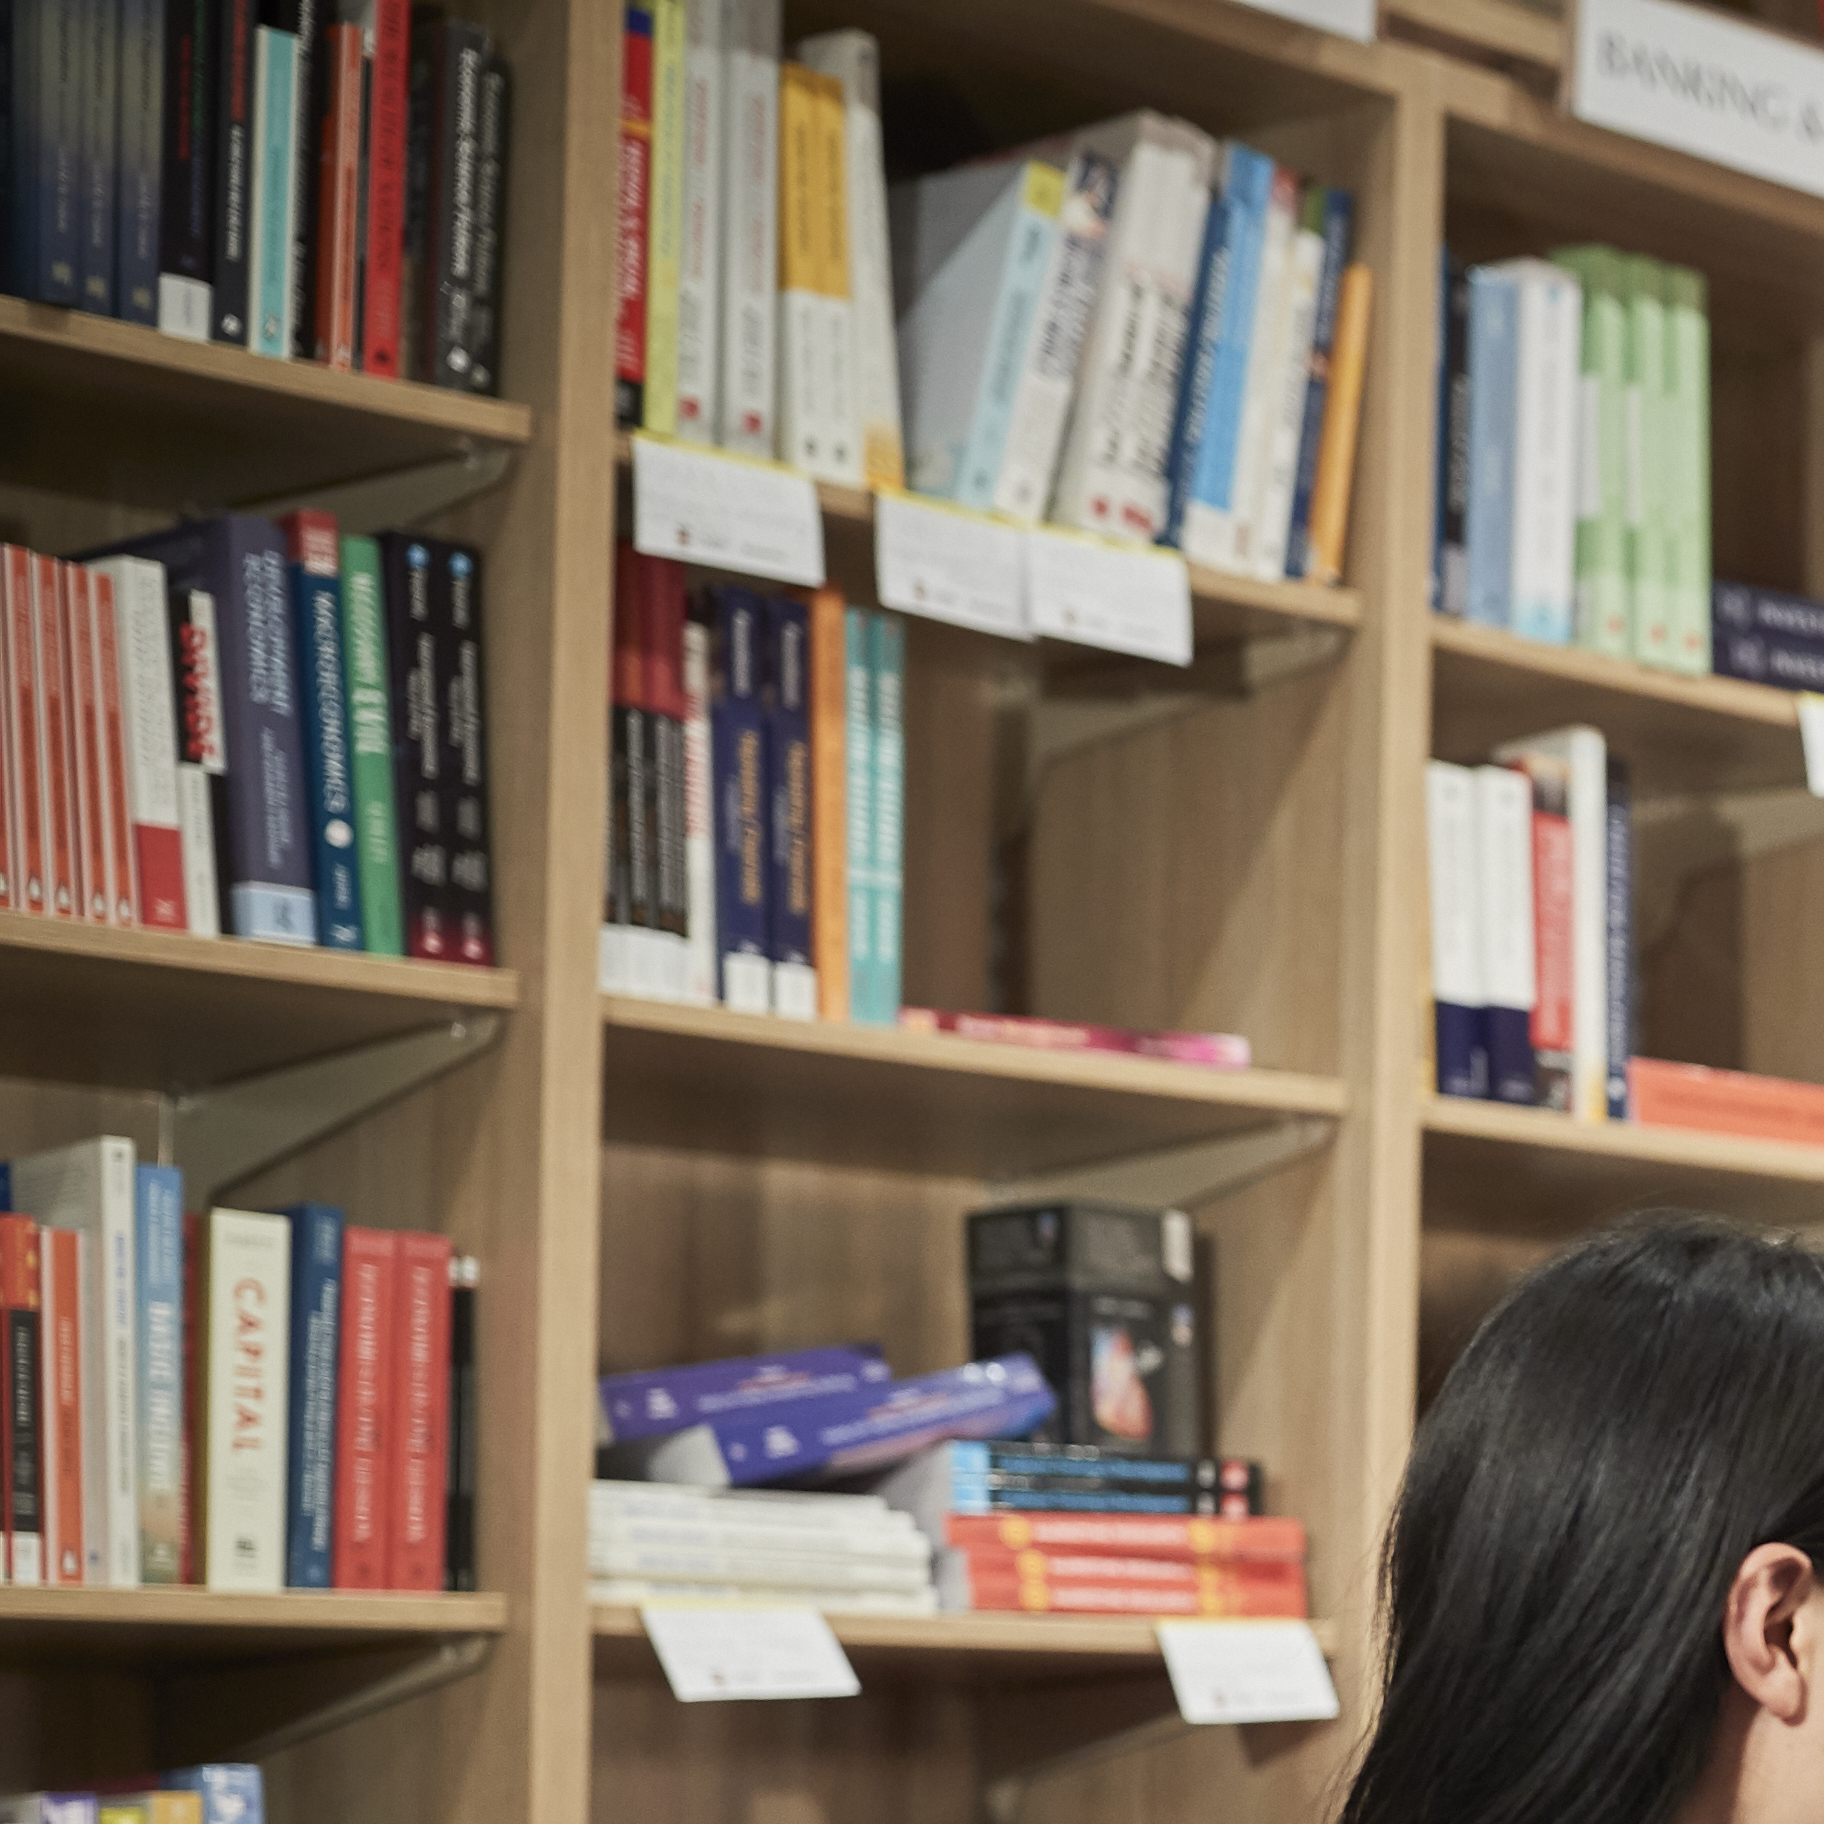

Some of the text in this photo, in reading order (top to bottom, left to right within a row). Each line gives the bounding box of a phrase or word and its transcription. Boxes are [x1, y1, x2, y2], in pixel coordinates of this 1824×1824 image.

[1597, 34, 1795, 136] BANKING
[1802, 101, 1824, 139] &
[179, 623, 216, 760] DIVIDE
[312, 590, 349, 811] MACROECONOMICS
[230, 1278, 268, 1454] CAPITAL
[148, 1389, 177, 1491] INCOME
